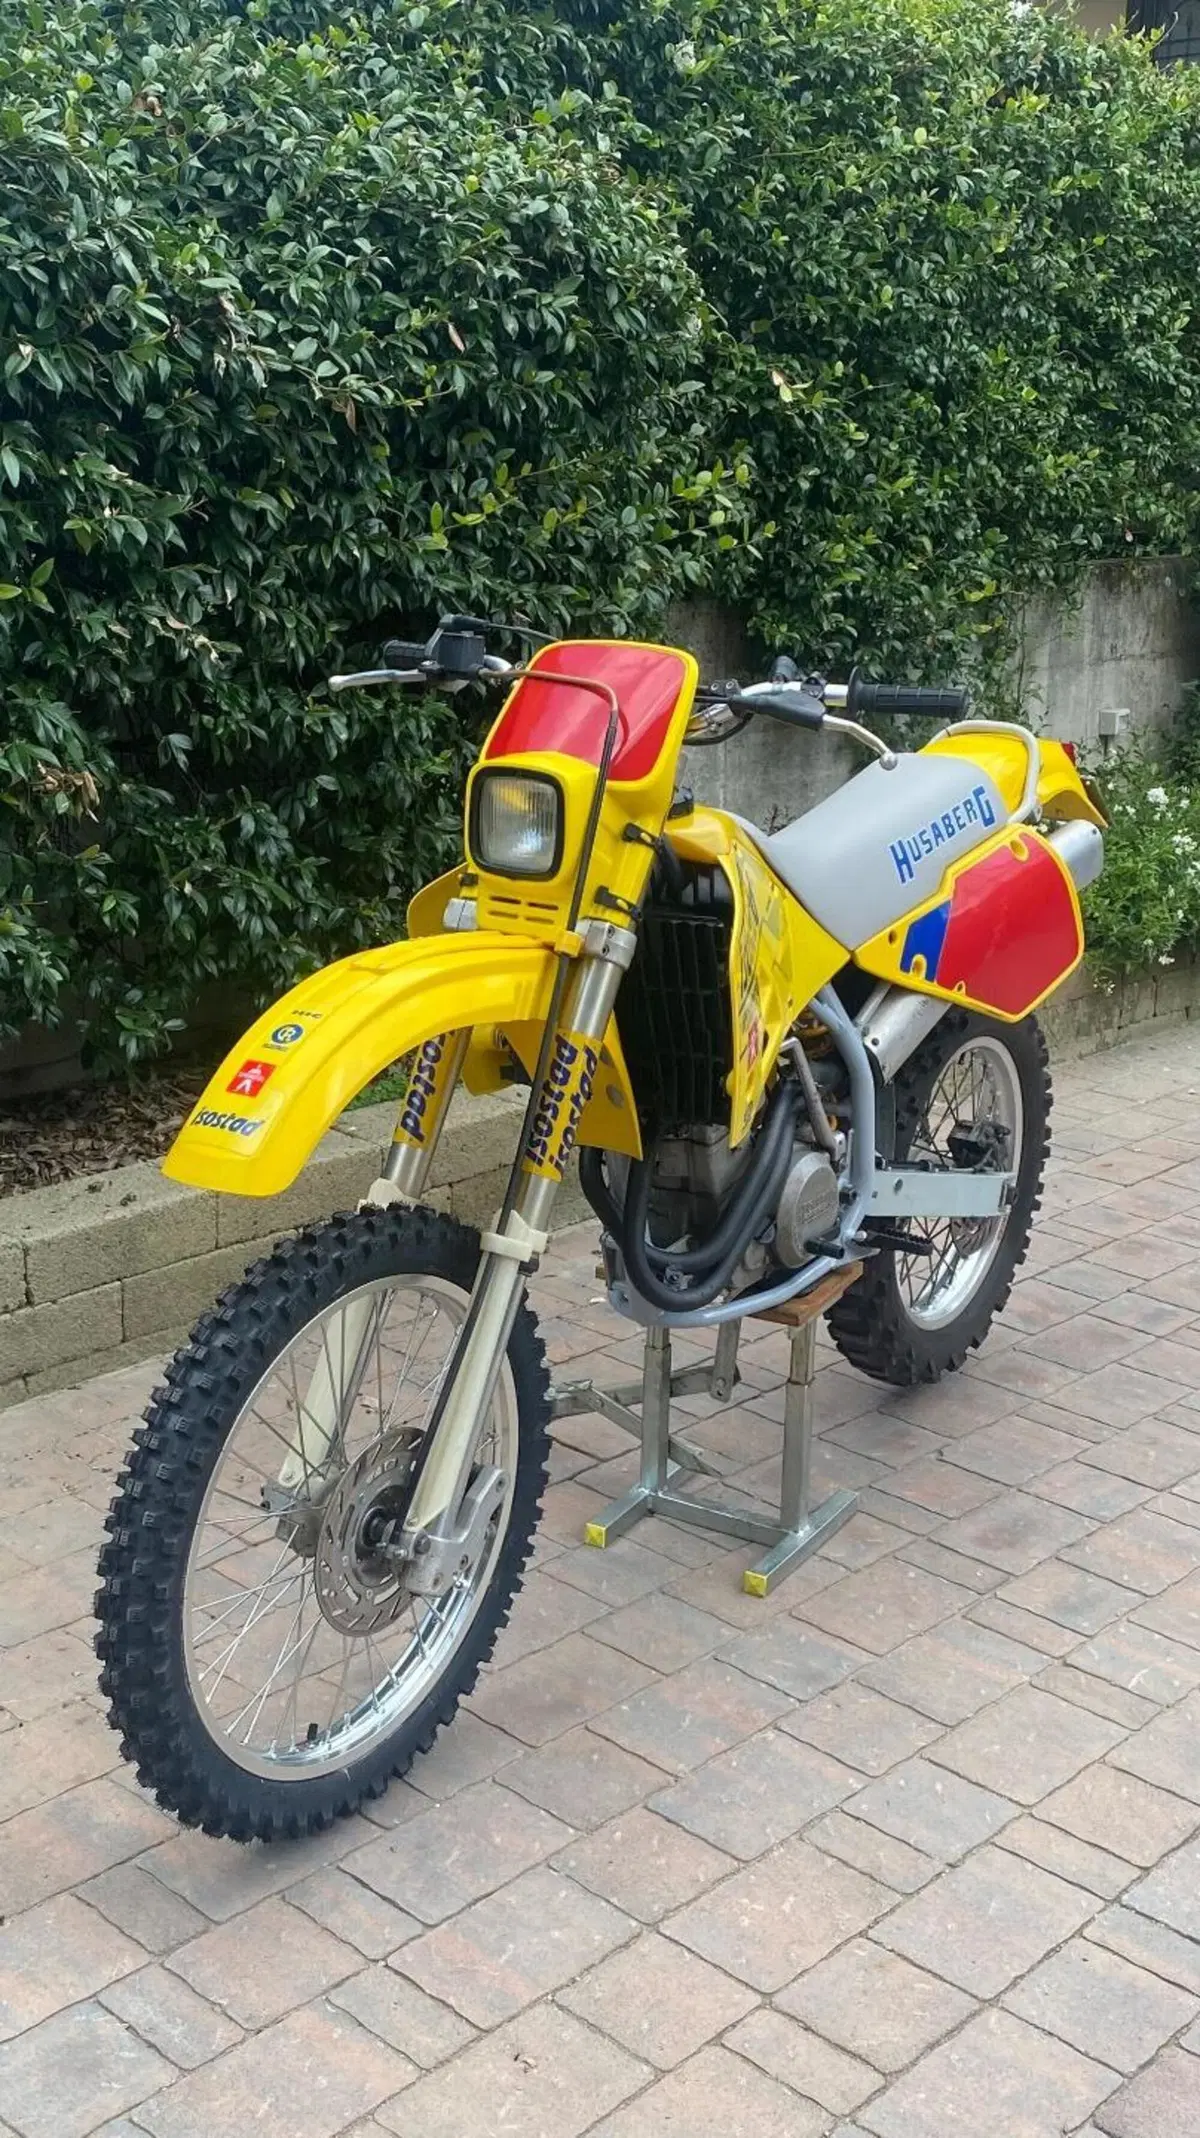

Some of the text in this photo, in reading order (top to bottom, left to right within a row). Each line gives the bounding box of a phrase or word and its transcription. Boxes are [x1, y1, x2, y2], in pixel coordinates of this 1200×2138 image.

[889, 785, 996, 884] HUSABERG
[190, 1107, 266, 1137] isostad
[401, 1031, 453, 1143] ostad
